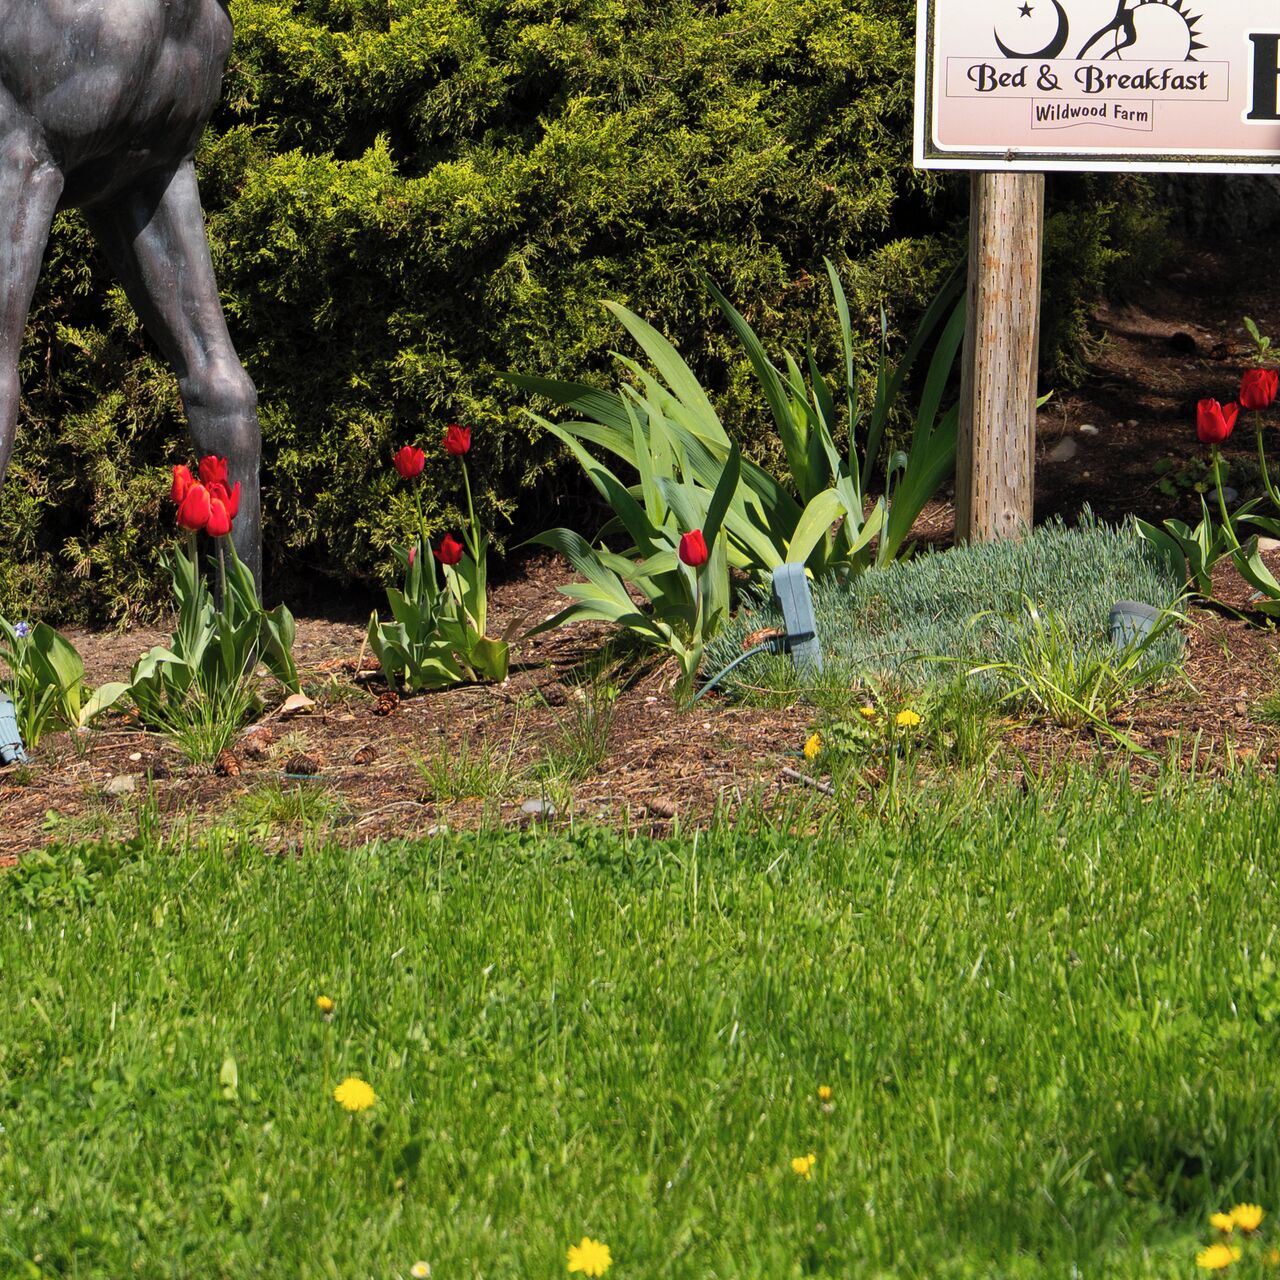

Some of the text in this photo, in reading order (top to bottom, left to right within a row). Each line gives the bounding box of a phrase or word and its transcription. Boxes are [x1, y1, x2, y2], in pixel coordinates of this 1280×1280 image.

[967, 63, 1209, 94] Bed & Breakfast
[1036, 103, 1148, 122] Wildwood Farm
